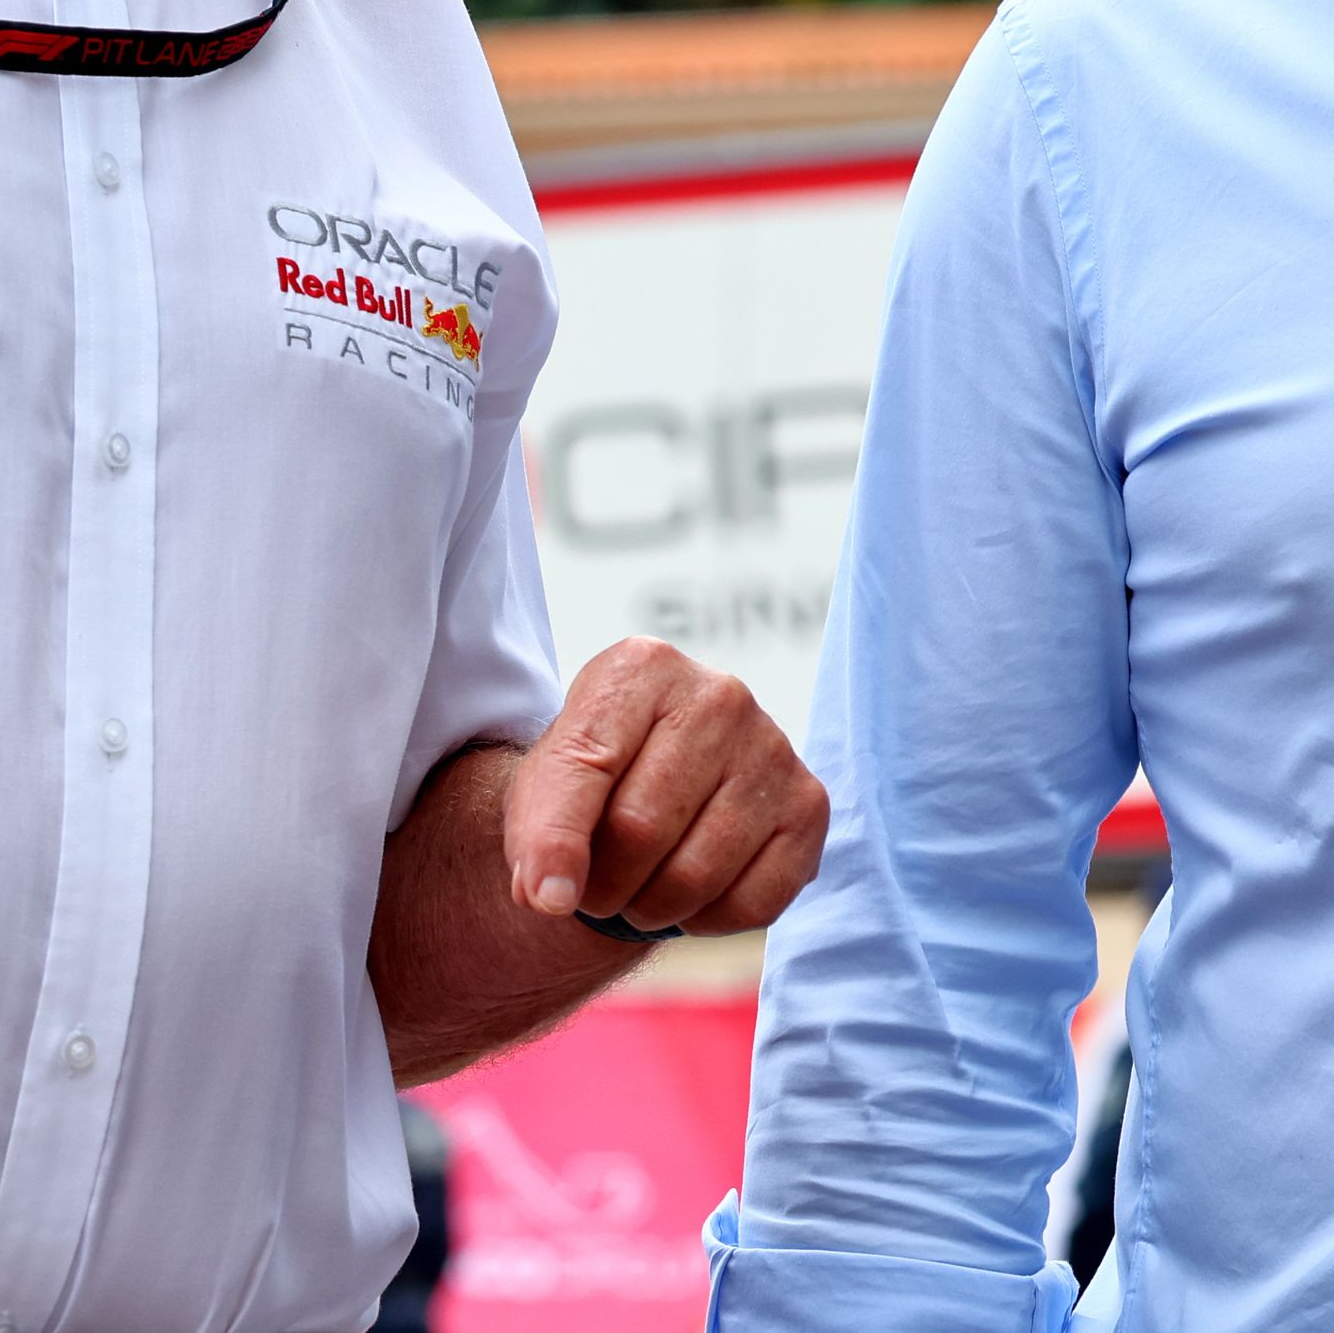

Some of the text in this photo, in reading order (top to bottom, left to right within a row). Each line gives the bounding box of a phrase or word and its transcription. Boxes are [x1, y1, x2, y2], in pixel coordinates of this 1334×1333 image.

[81, 37, 134, 64] PIT
[135, 39, 219, 67] LANE
[267, 201, 503, 311] ORACLE
[275, 256, 413, 329] Red Bull
